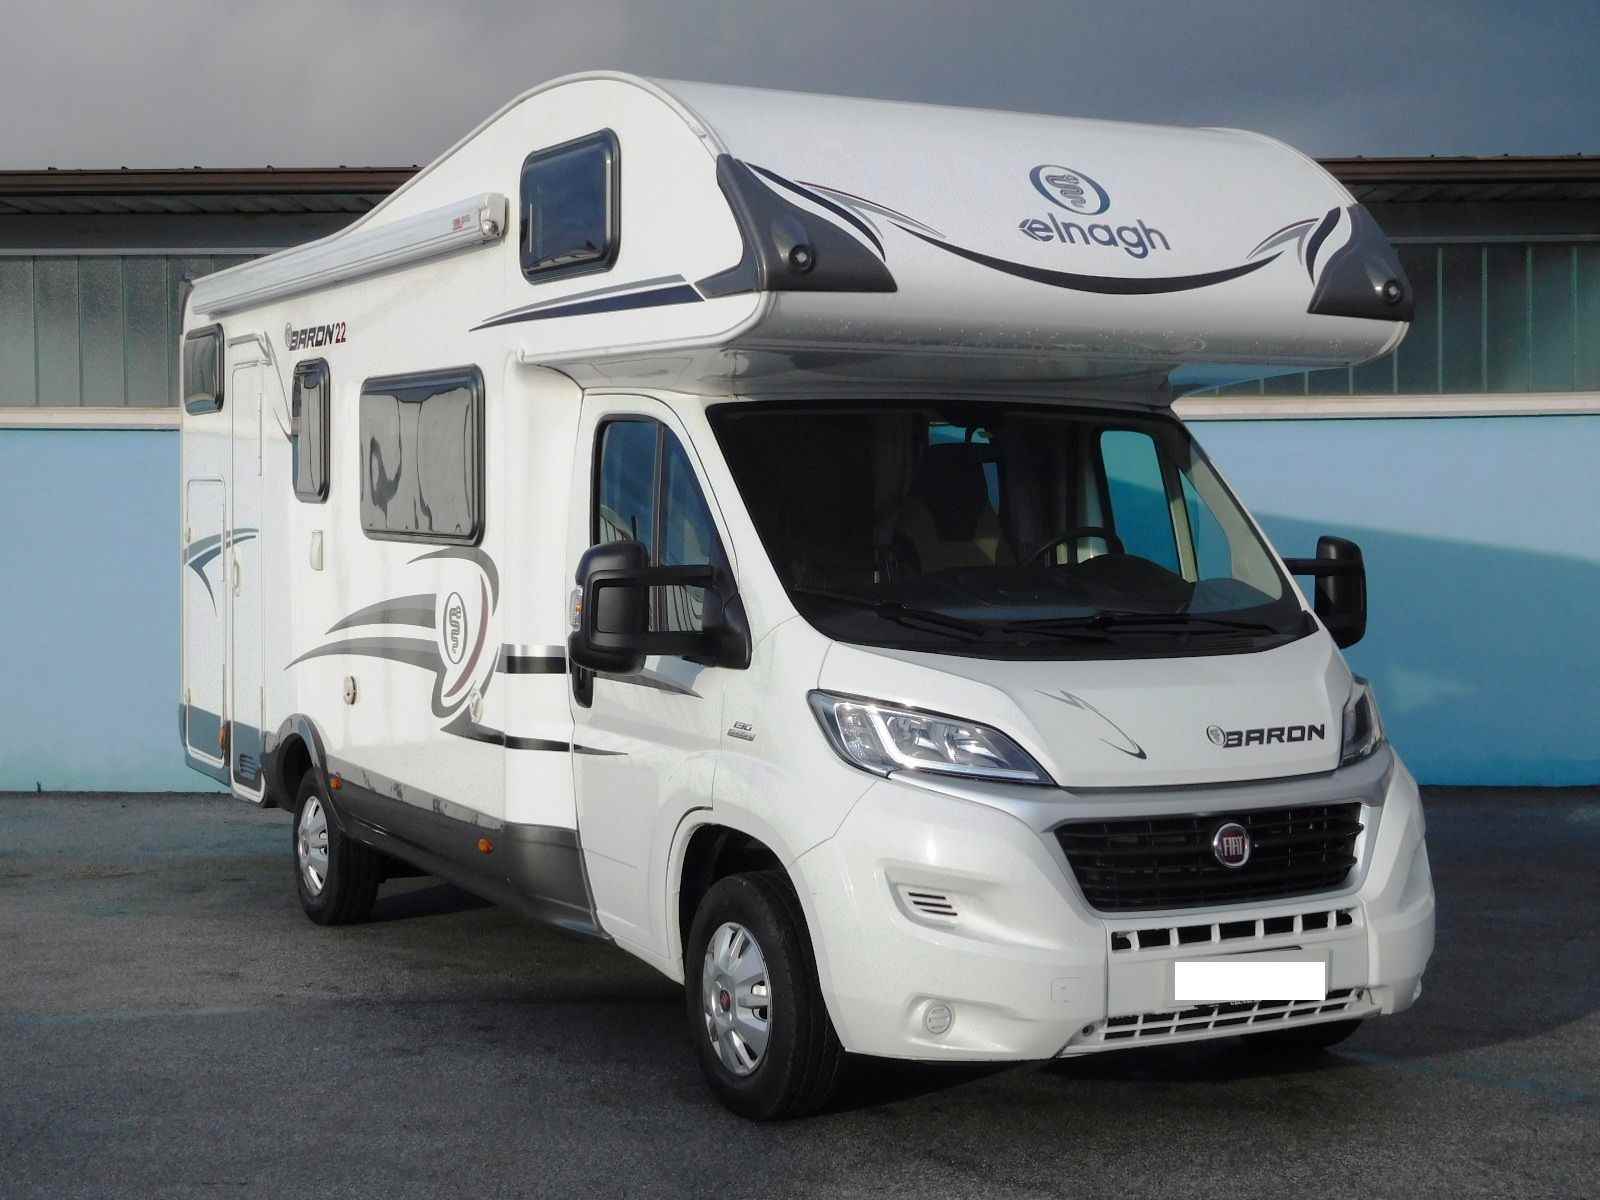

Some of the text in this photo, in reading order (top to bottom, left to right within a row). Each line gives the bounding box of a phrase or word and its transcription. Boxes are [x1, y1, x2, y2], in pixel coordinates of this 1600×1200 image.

[1018, 212, 1171, 259] elnagh
[289, 323, 335, 351] BARON
[1222, 723, 1325, 748] BARON
[1223, 836, 1244, 857] FIAT
